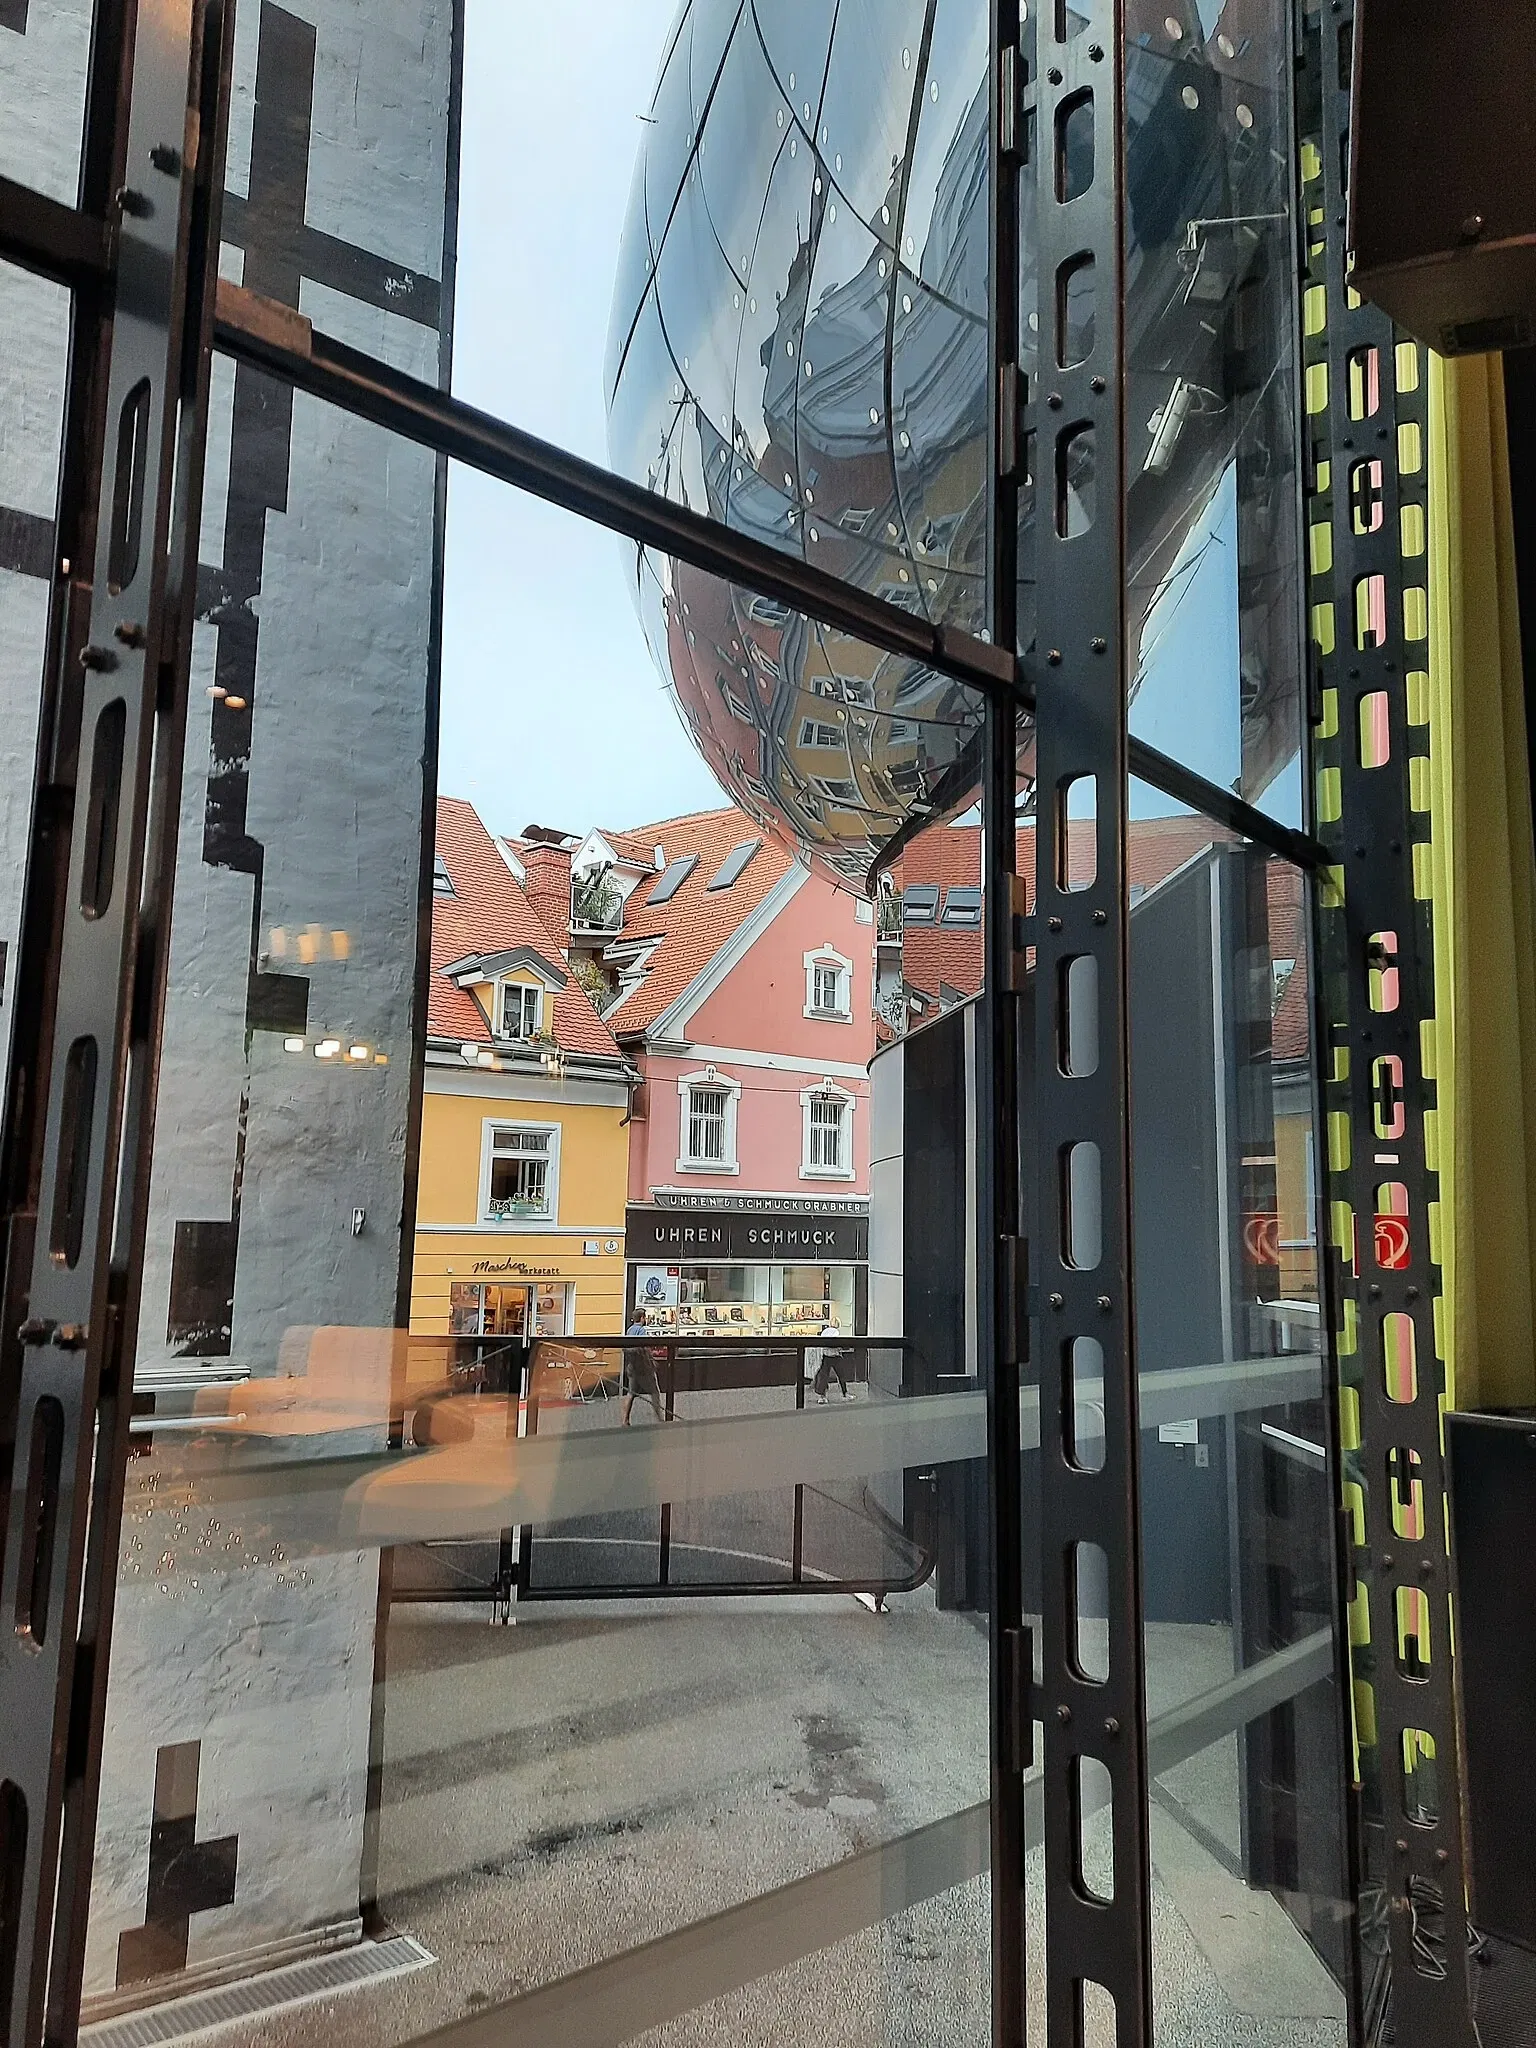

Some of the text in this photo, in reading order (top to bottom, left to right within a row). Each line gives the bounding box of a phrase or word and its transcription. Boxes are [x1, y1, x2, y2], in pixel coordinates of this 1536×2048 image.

[669, 1195, 862, 1212] UHREN & SCHMUCK GRABNER
[655, 1227, 836, 1245] UHREN SCHMUCK
